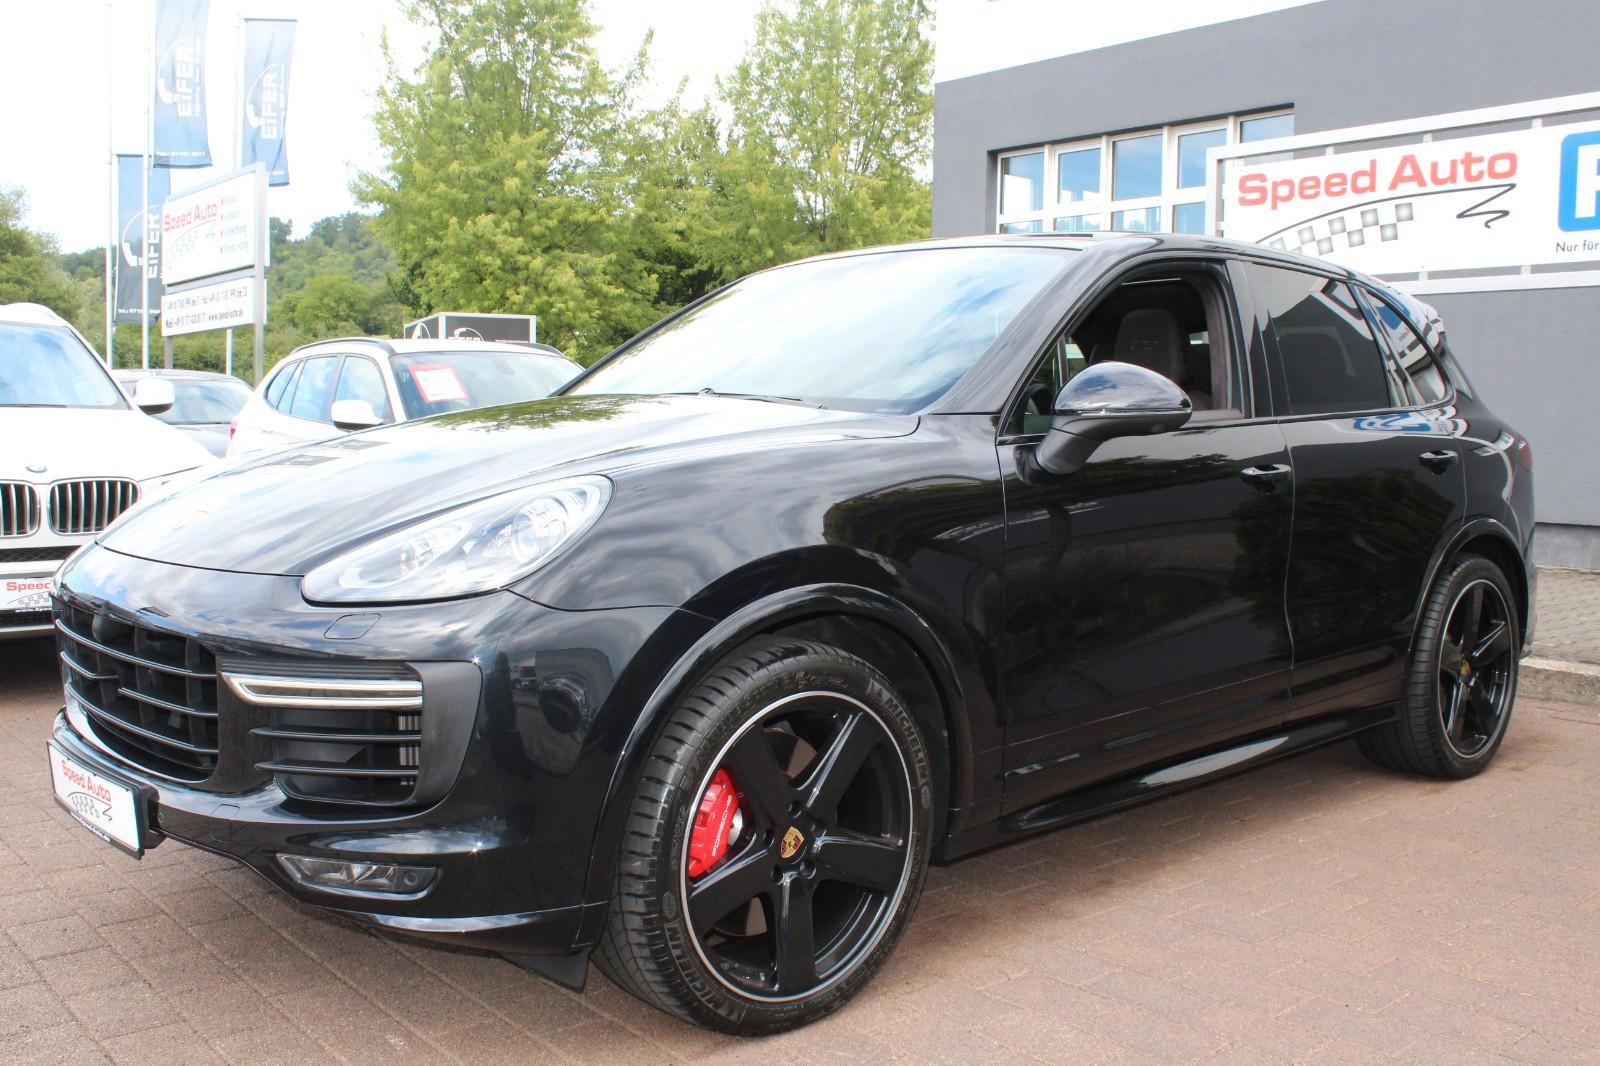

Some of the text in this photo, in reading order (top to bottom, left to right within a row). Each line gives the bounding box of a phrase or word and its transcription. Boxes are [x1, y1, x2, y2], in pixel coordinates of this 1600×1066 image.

[1238, 151, 1519, 211] Speed Auto
[164, 203, 218, 232] Speed Auto
[1555, 239, 1600, 253] Nur für
[884, 694, 929, 782] MICHELIN
[61, 759, 111, 803] Speed Auto
[711, 794, 734, 857] PORSCHE
[664, 923, 727, 1019] MICHELIN
